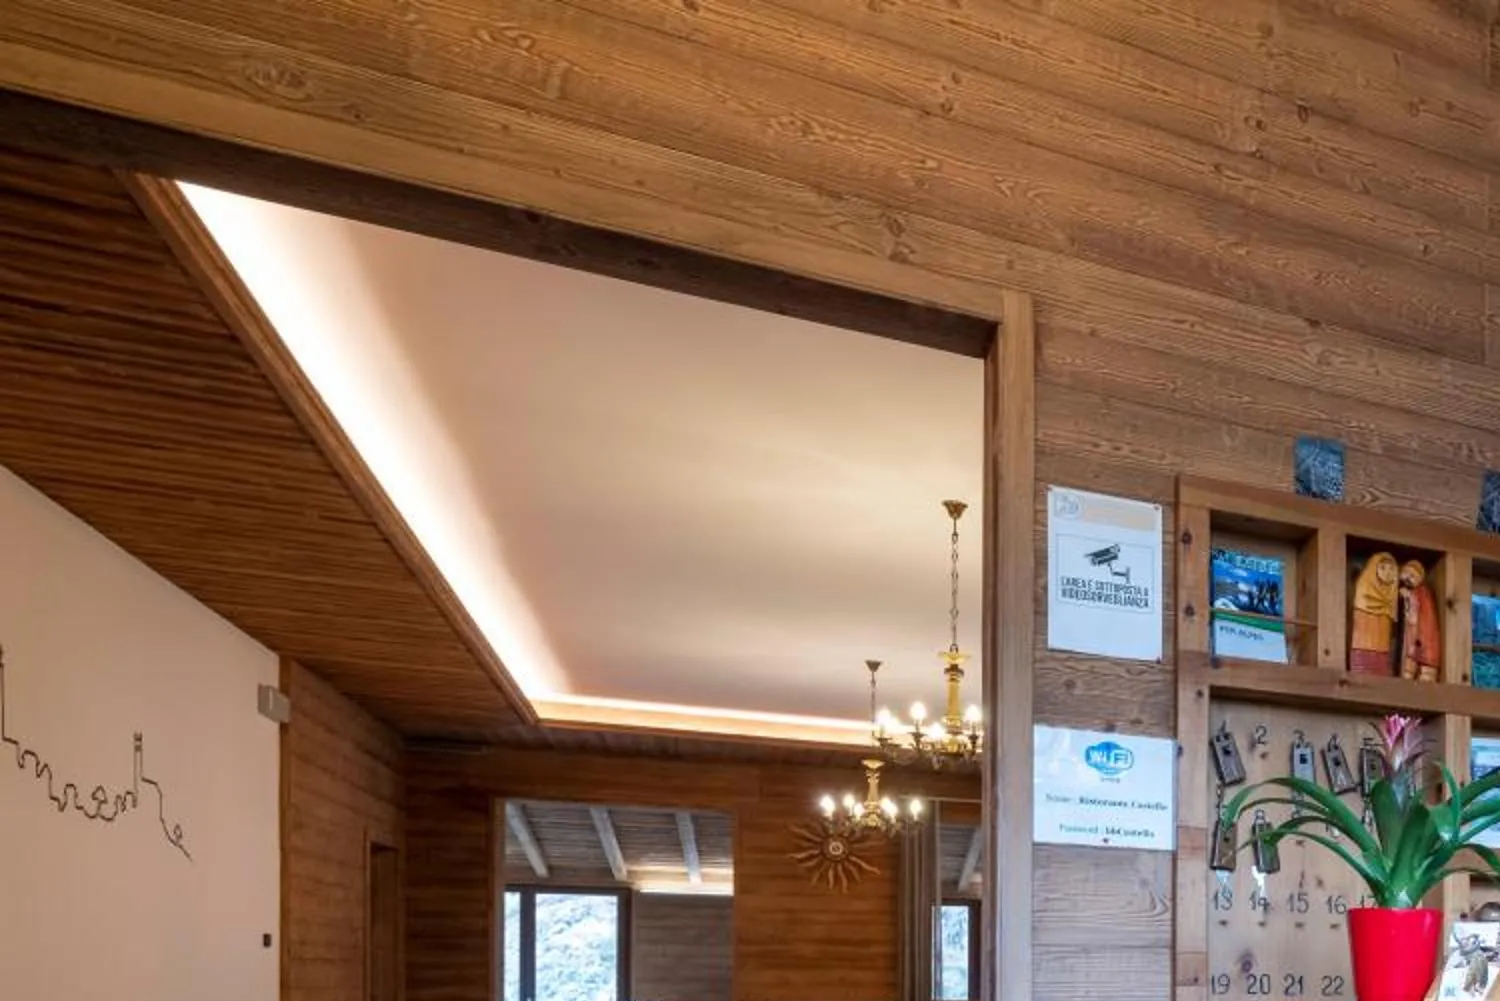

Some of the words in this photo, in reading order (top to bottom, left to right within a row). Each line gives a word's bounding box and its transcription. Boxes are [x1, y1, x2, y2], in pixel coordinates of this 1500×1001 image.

[1255, 725, 1267, 745] 2
[1288, 891, 1309, 914] 15
[1326, 894, 1347, 915] 16
[1211, 973, 1231, 995] 19
[1247, 973, 1271, 995] 20
[1283, 974, 1304, 996] 21
[1321, 975, 1345, 996] 22
